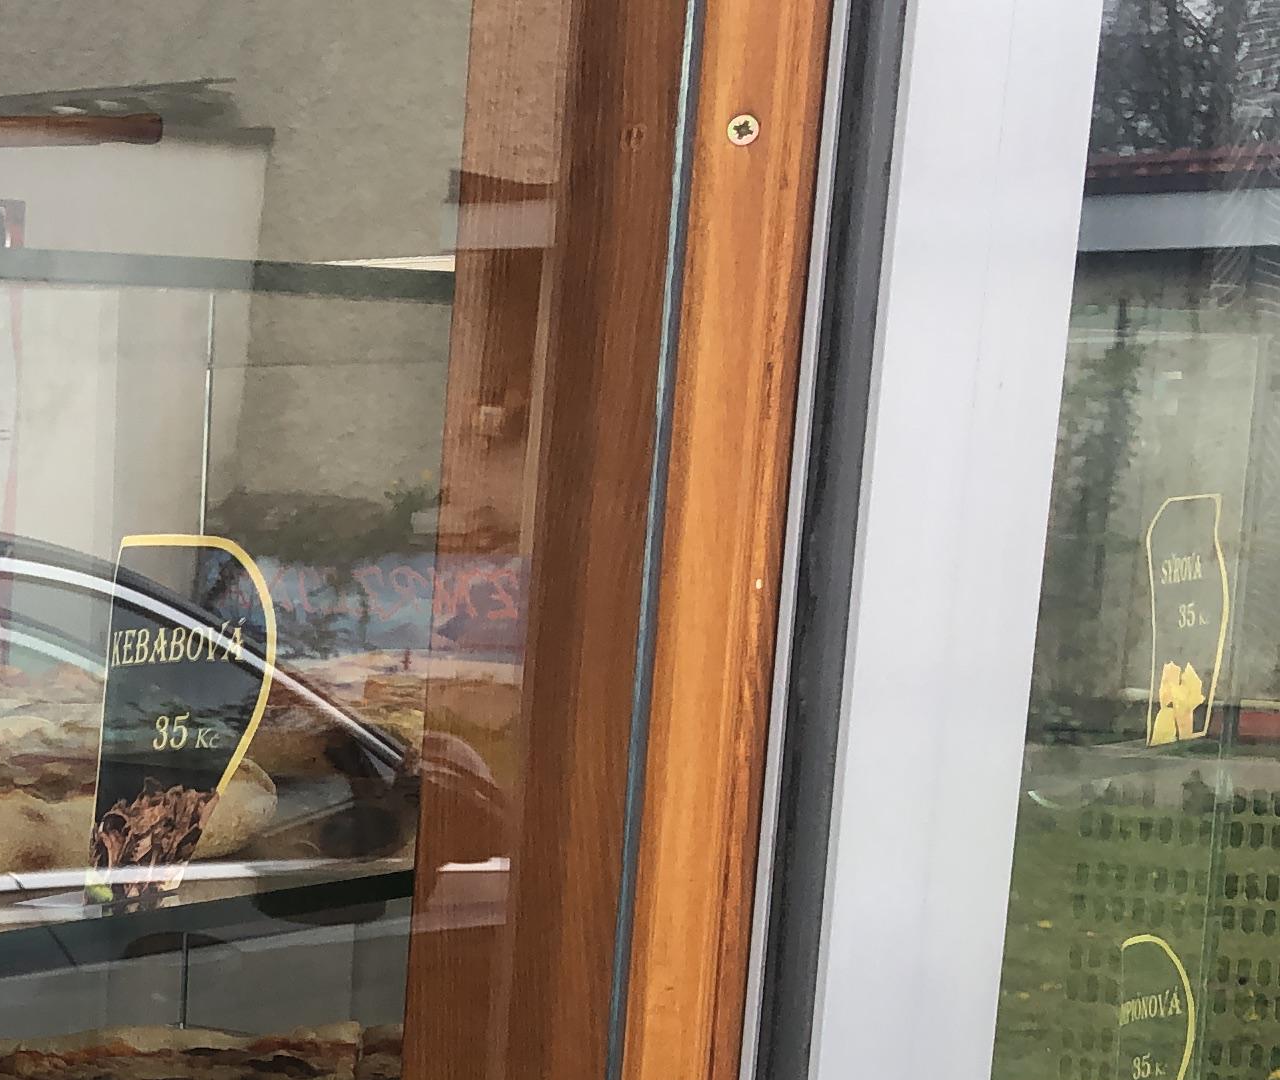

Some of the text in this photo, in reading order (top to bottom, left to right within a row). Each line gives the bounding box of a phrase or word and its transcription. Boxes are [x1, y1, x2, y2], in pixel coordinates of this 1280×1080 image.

[1178, 603, 1195, 628] 35
[111, 617, 246, 667] KEBABOVÁ
[153, 712, 189, 752] 35
[1133, 1052, 1151, 1080] 35
